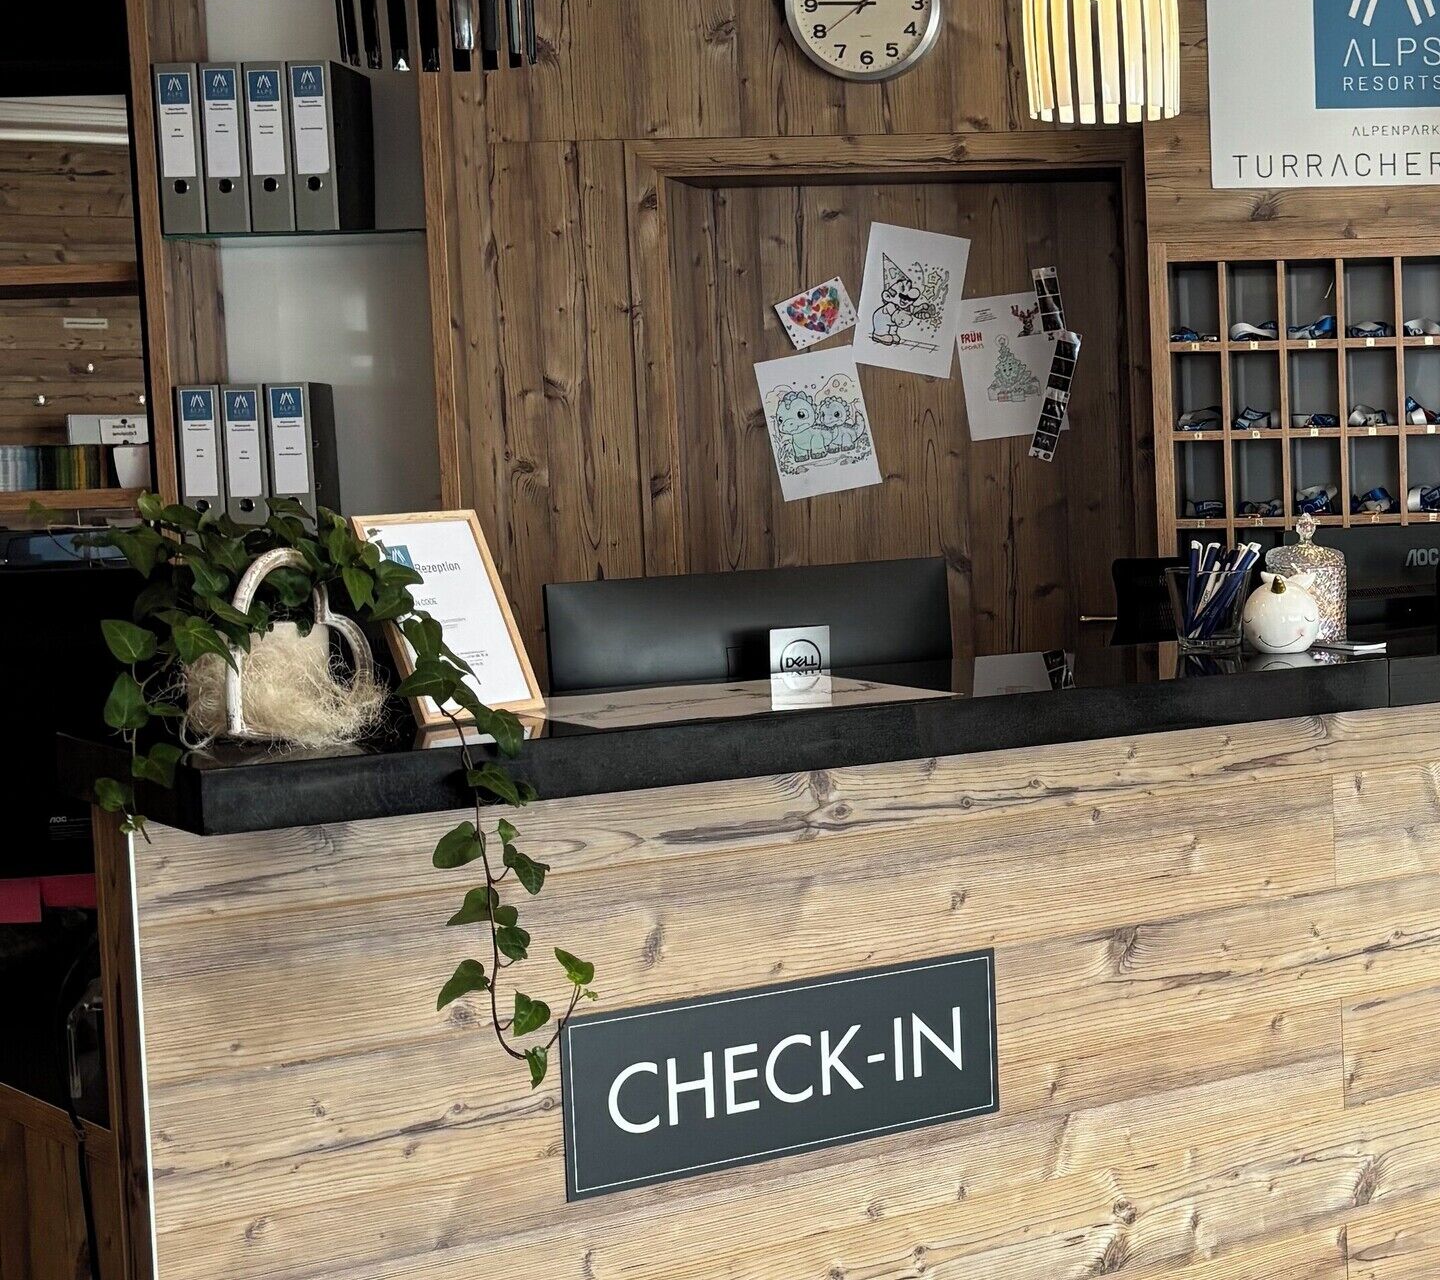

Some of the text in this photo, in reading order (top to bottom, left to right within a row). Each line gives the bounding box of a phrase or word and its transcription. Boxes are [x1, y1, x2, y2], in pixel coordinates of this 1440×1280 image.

[813, 24, 827, 39] 8
[903, 21, 917, 36] 4
[834, 44, 847, 58] 7
[886, 43, 899, 57] 5
[860, 50, 874, 65] 6
[1351, 124, 1440, 137] ALPENPARK
[1405, 548, 1439, 566] AOC
[414, 561, 461, 574] Rezeption
[786, 655, 818, 669] DELL
[607, 1006, 963, 1134] CHECK-IN
